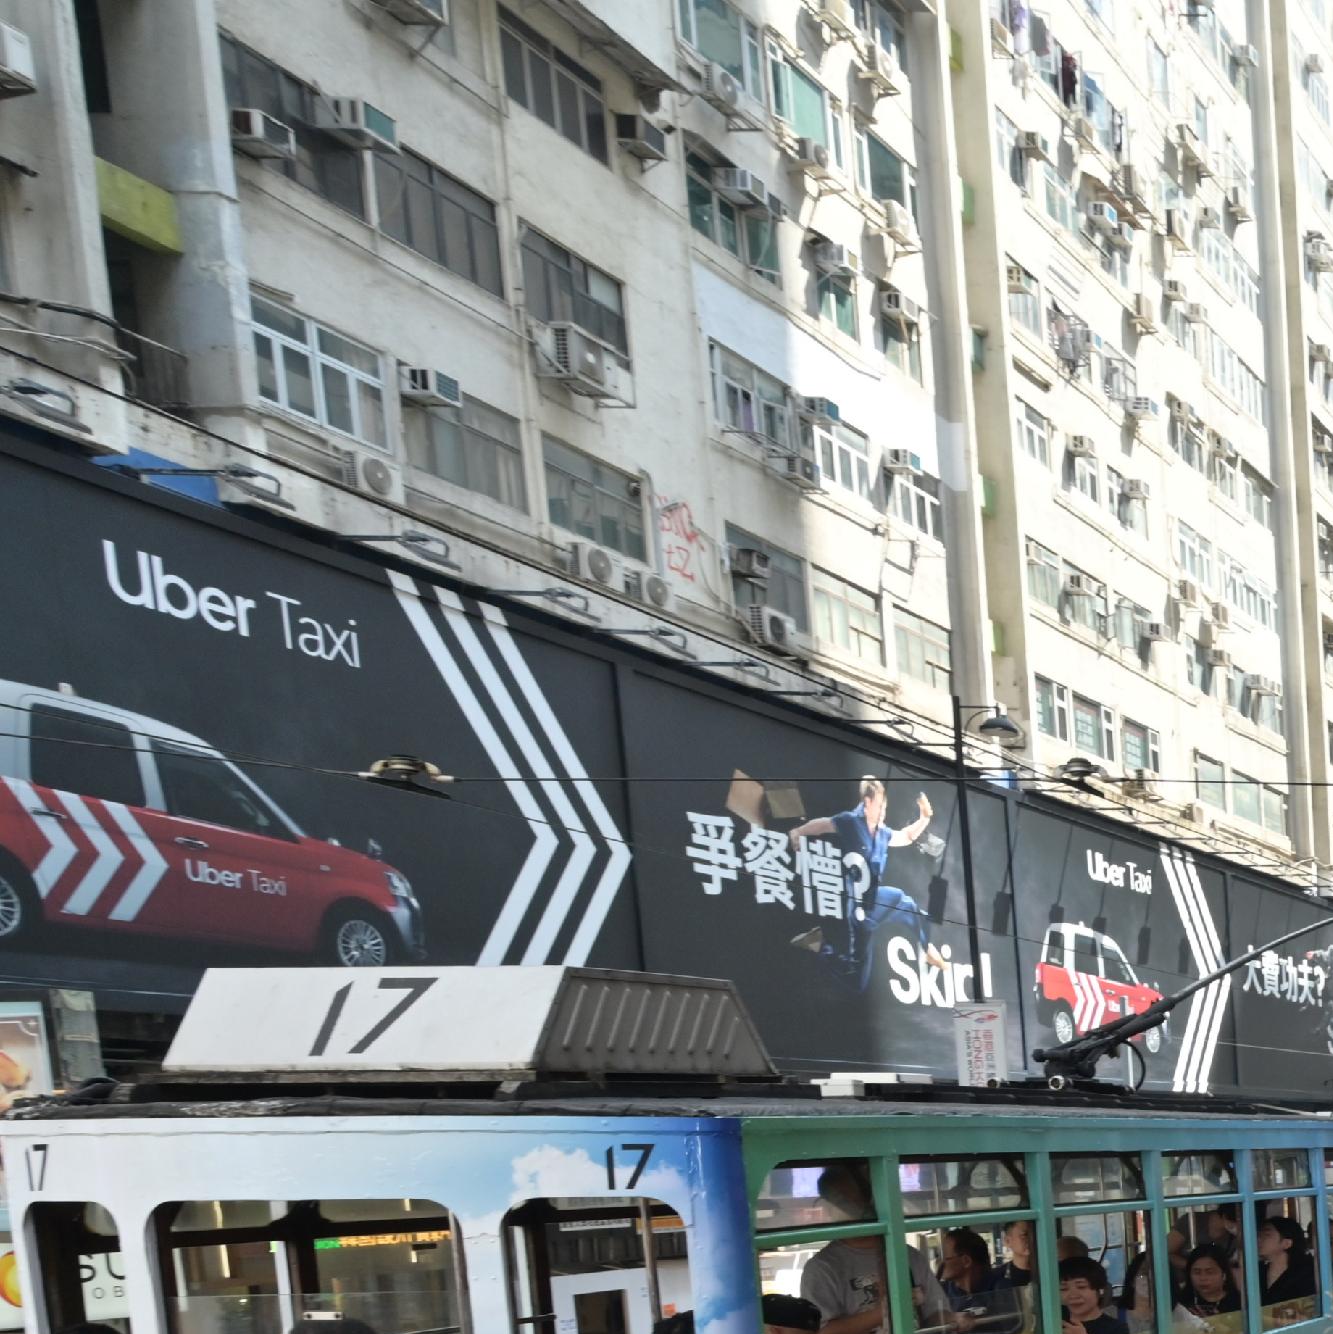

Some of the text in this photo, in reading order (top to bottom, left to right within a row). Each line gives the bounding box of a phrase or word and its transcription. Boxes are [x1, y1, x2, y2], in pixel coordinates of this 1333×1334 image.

[102, 539, 362, 669] Uber Taxi
[186, 860, 287, 897] Uber Taxi
[1087, 849, 1152, 894] Uber Taxi
[308, 976, 439, 1056] 17
[24, 1144, 49, 1192] 17
[605, 1144, 654, 1191] 17
